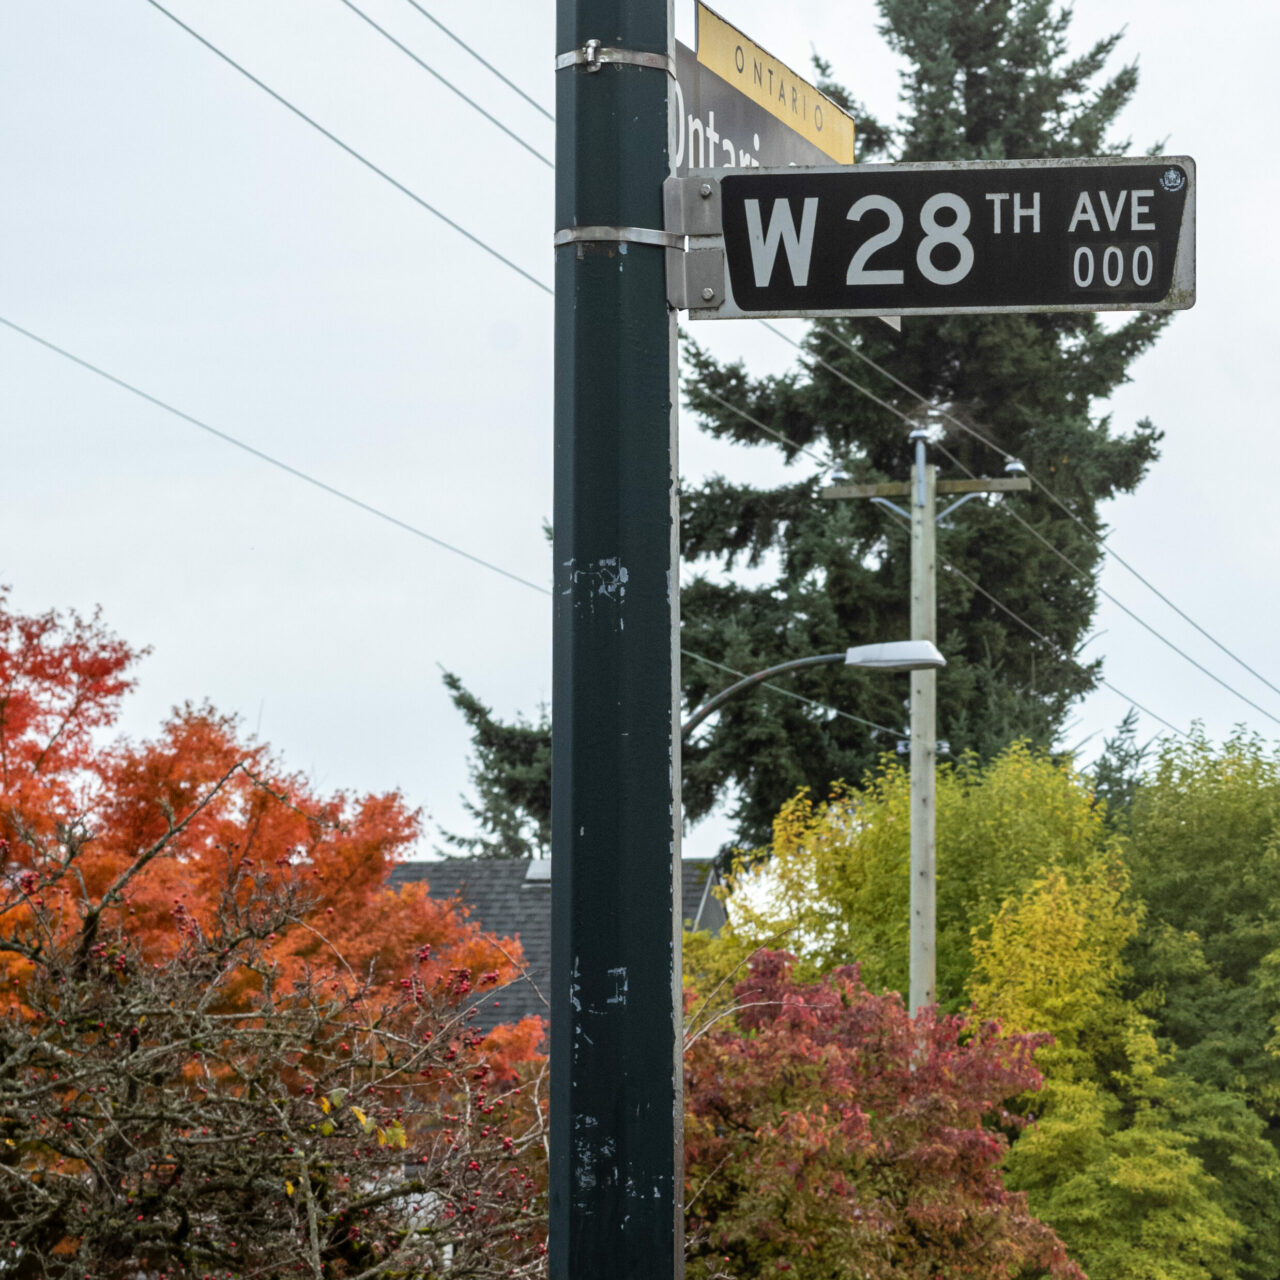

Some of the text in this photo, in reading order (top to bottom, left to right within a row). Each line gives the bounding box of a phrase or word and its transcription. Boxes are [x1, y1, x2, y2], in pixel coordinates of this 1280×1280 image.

[675, 80, 797, 169] Ontai
[734, 45, 824, 131] ONTARIO
[743, 196, 819, 288] W
[1068, 189, 1156, 232] AVE
[1072, 245, 1155, 288] 000
